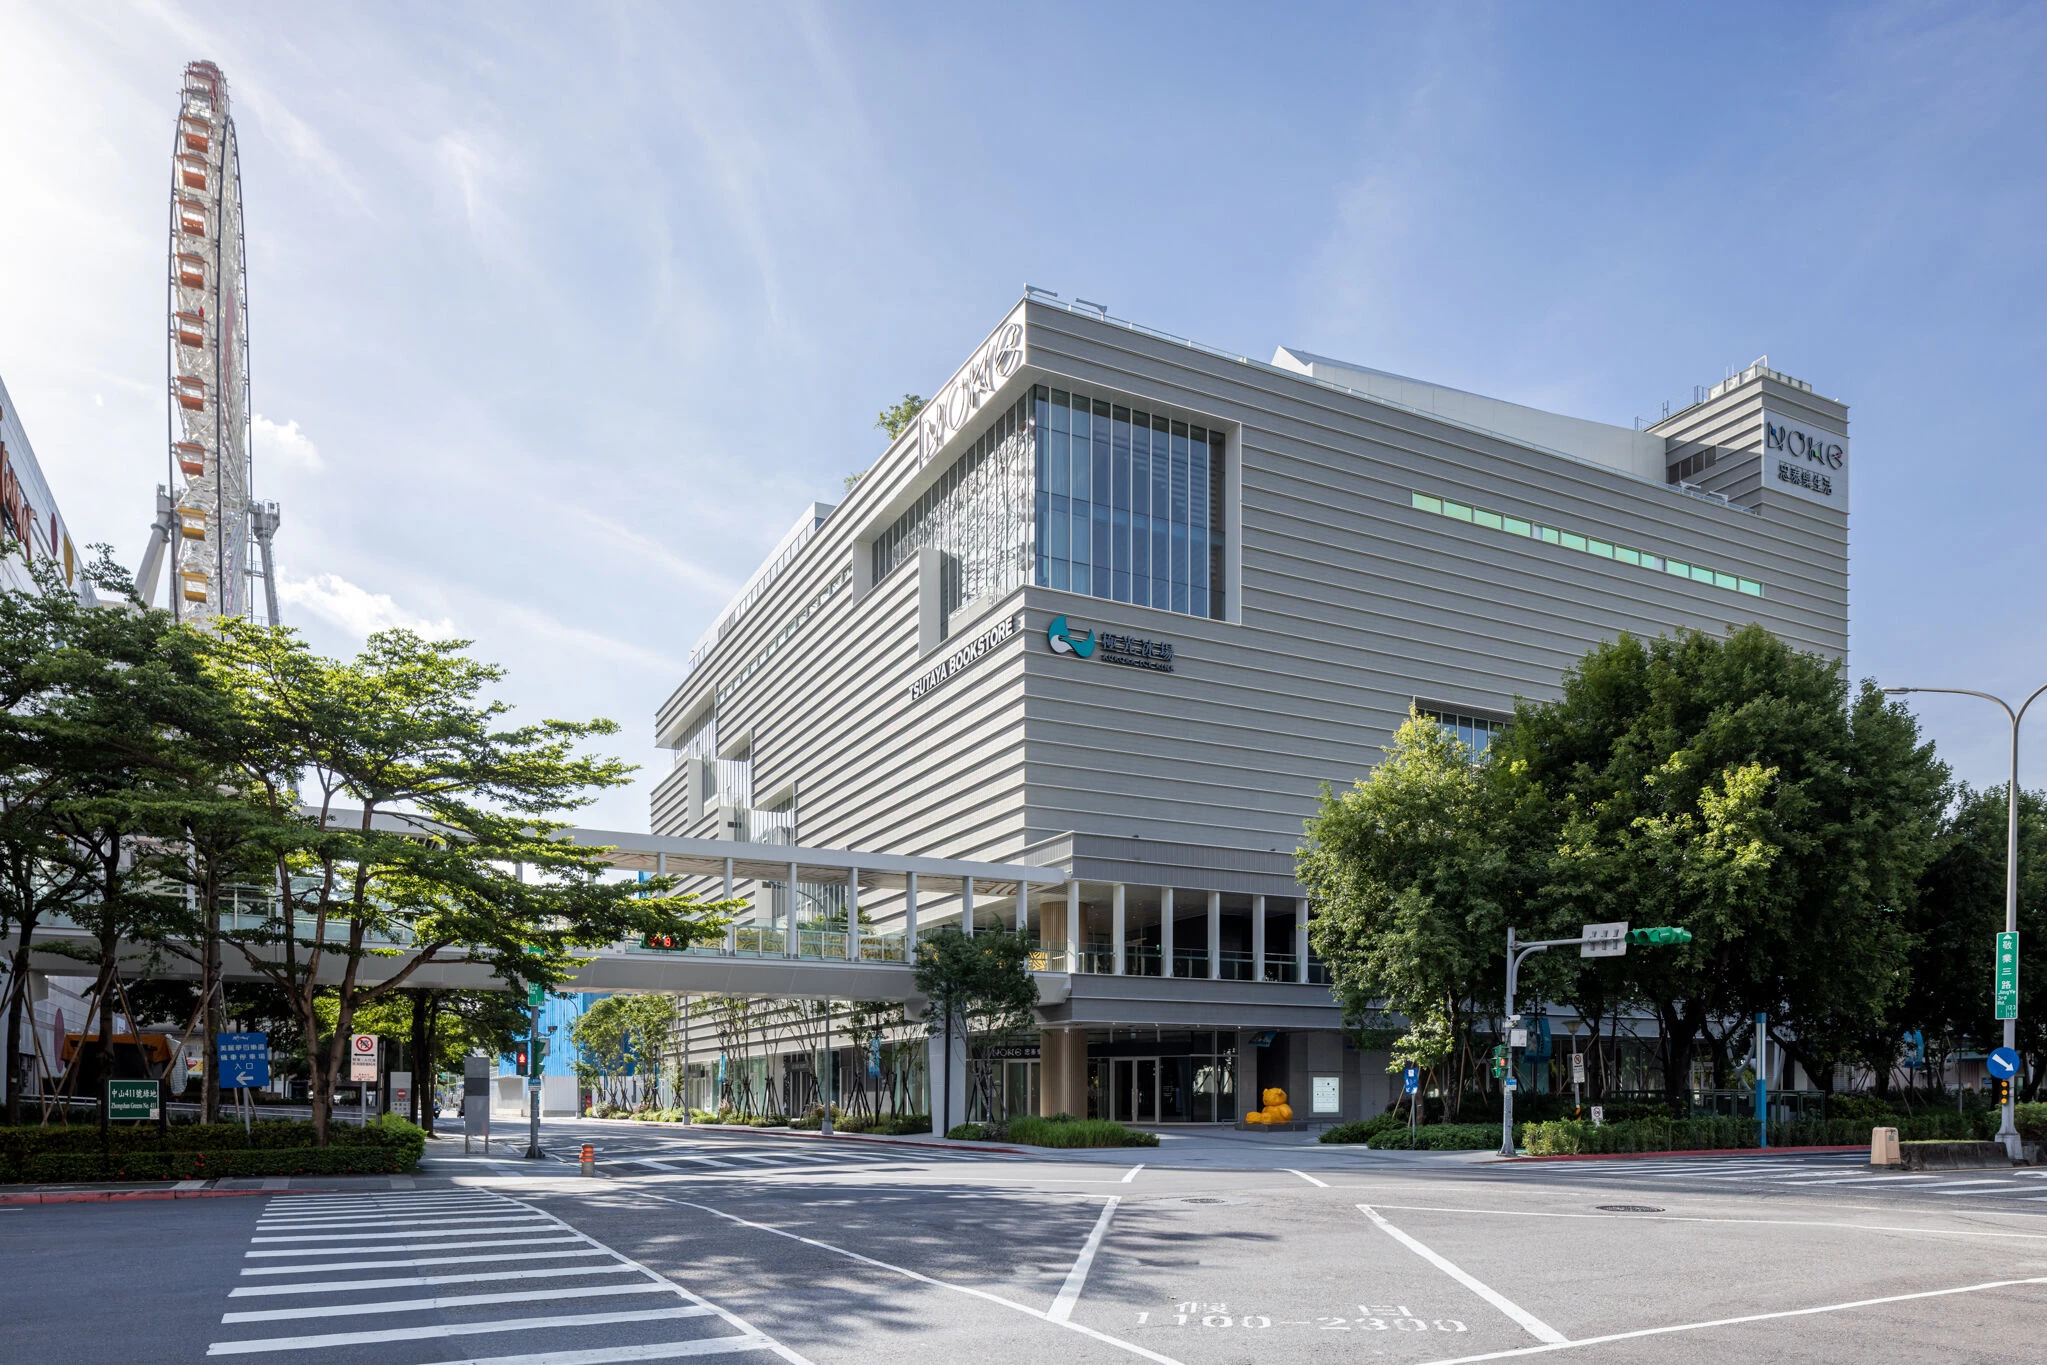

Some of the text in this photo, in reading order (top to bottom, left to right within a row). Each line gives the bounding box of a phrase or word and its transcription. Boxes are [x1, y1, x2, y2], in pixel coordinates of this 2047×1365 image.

[908, 615, 1014, 700] TSUTAYA BOOKSTORE
[1101, 631, 1175, 661] 極光冰場
[2002, 940, 2013, 990] 敬業三路
[234, 1062, 254, 1070] 入口
[111, 1088, 157, 1099] 中山411號綠地
